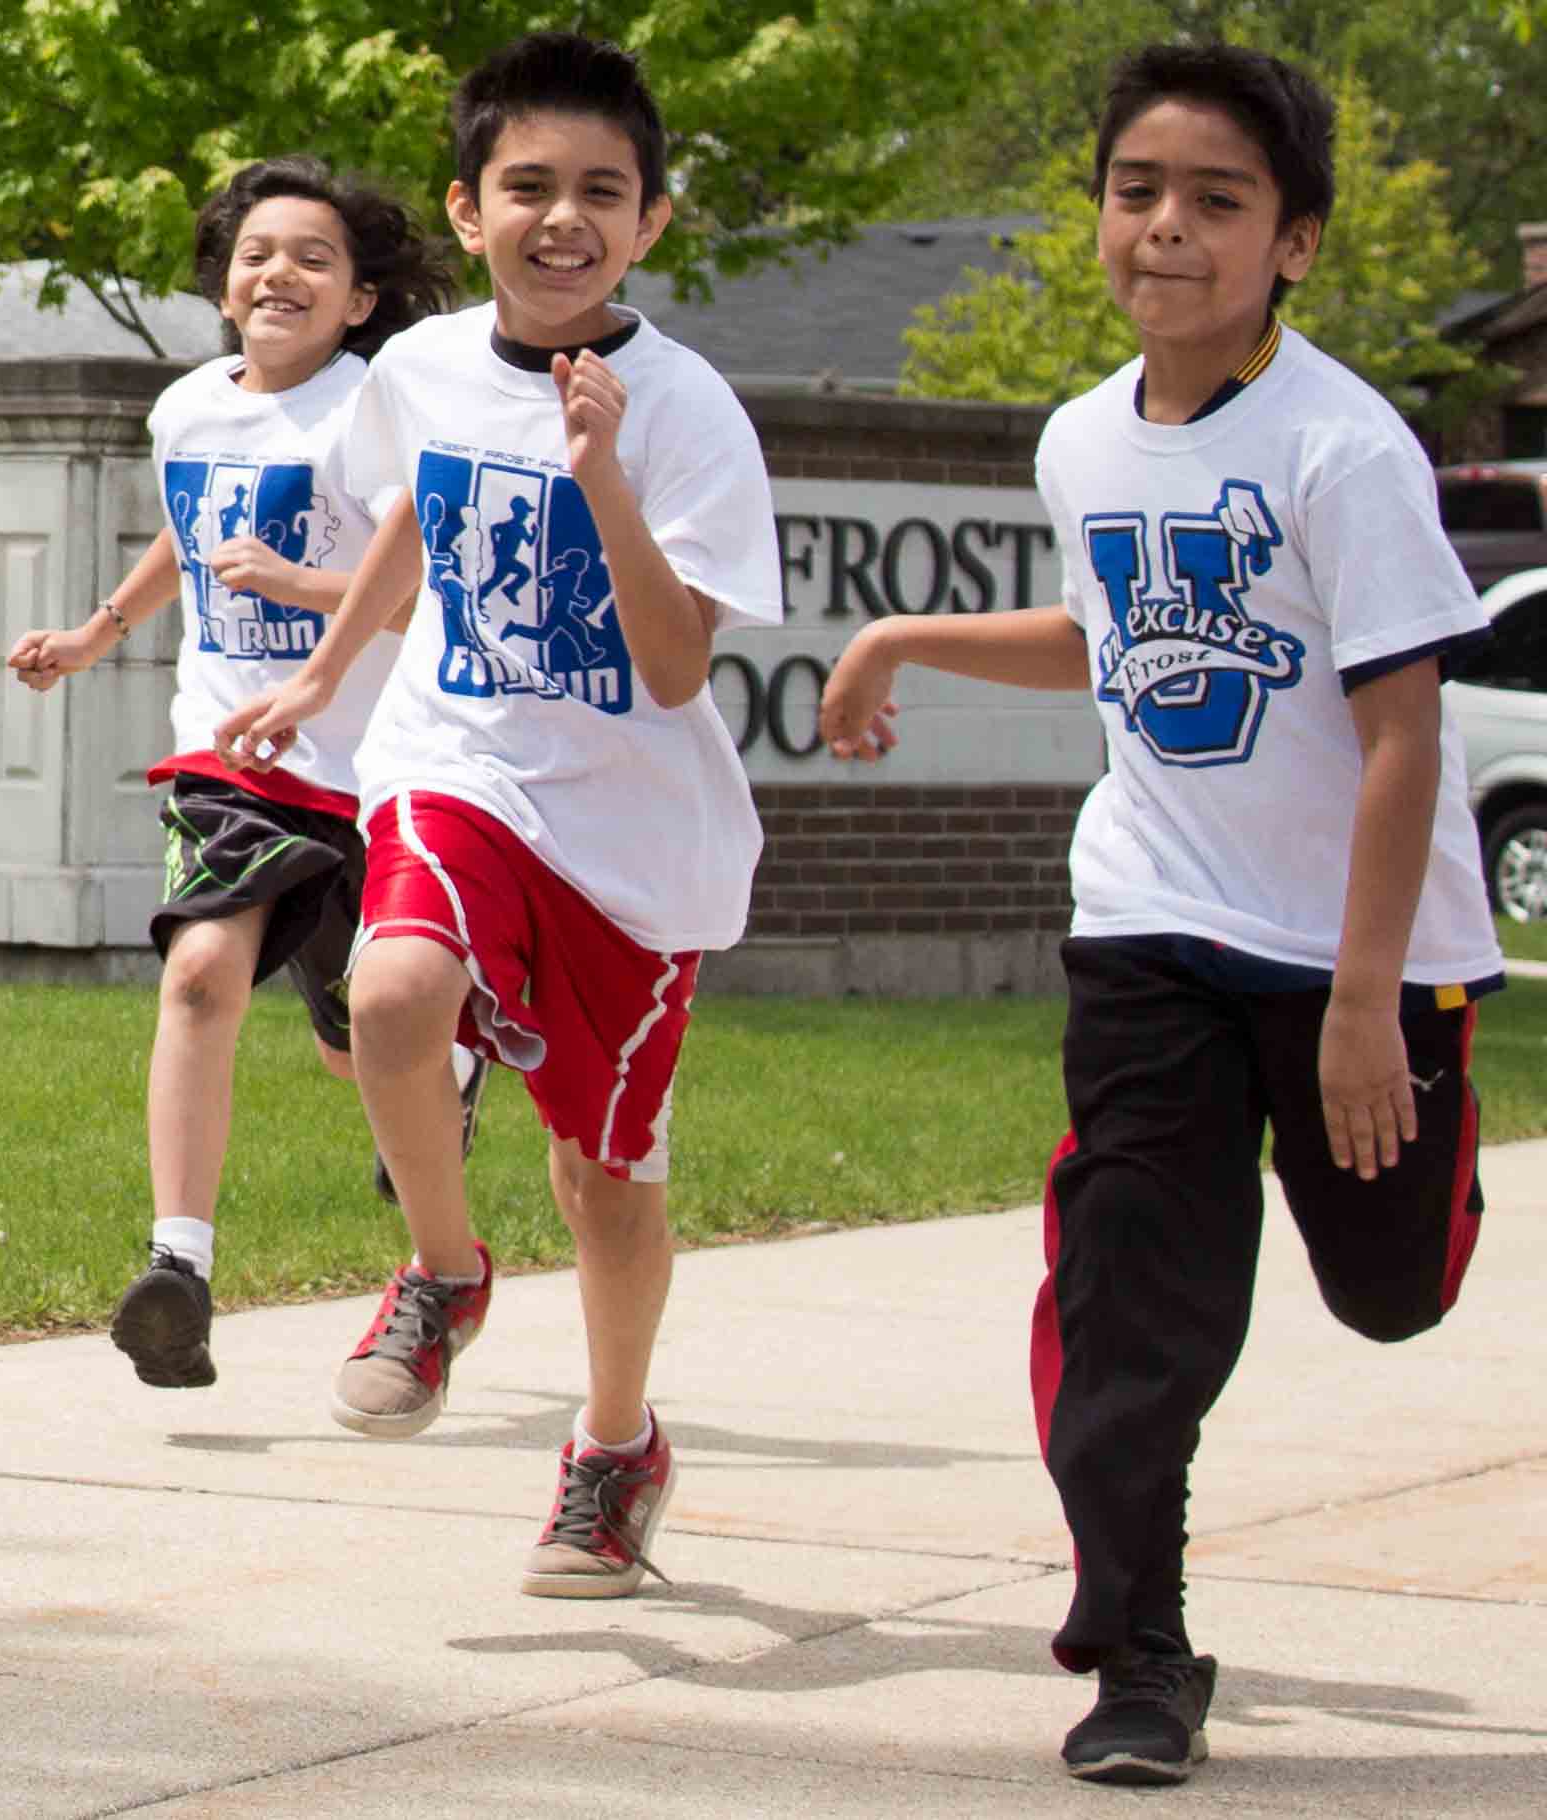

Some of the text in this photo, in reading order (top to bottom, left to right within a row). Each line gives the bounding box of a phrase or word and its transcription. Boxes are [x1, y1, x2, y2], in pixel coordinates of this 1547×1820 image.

[773, 513, 1056, 620] FROST
[1124, 649, 1211, 691] Frost
[1126, 602, 1294, 676] excuses
